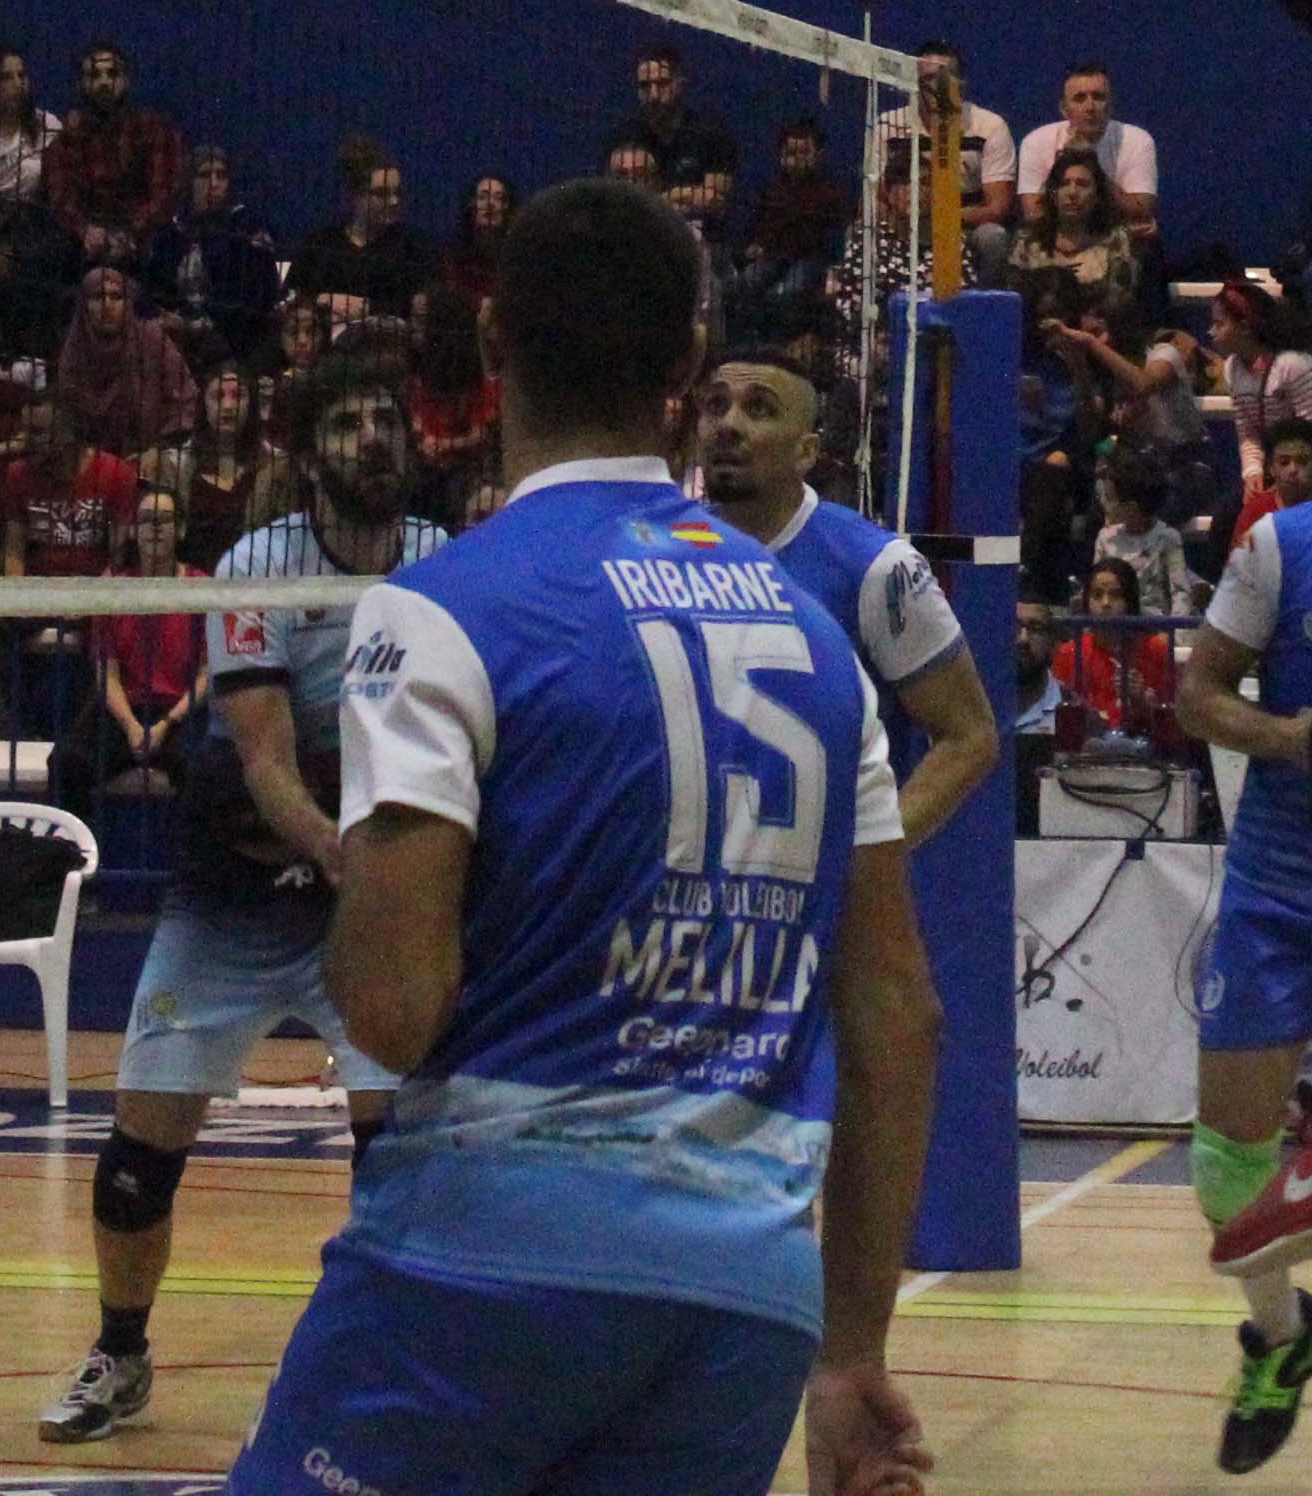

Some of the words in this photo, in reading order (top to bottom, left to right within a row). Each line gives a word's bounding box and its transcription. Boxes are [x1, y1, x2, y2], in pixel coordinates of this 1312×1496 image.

[601, 559, 794, 611] IRIBARNE
[635, 620, 827, 884] 15
[651, 879, 712, 917] CLUB
